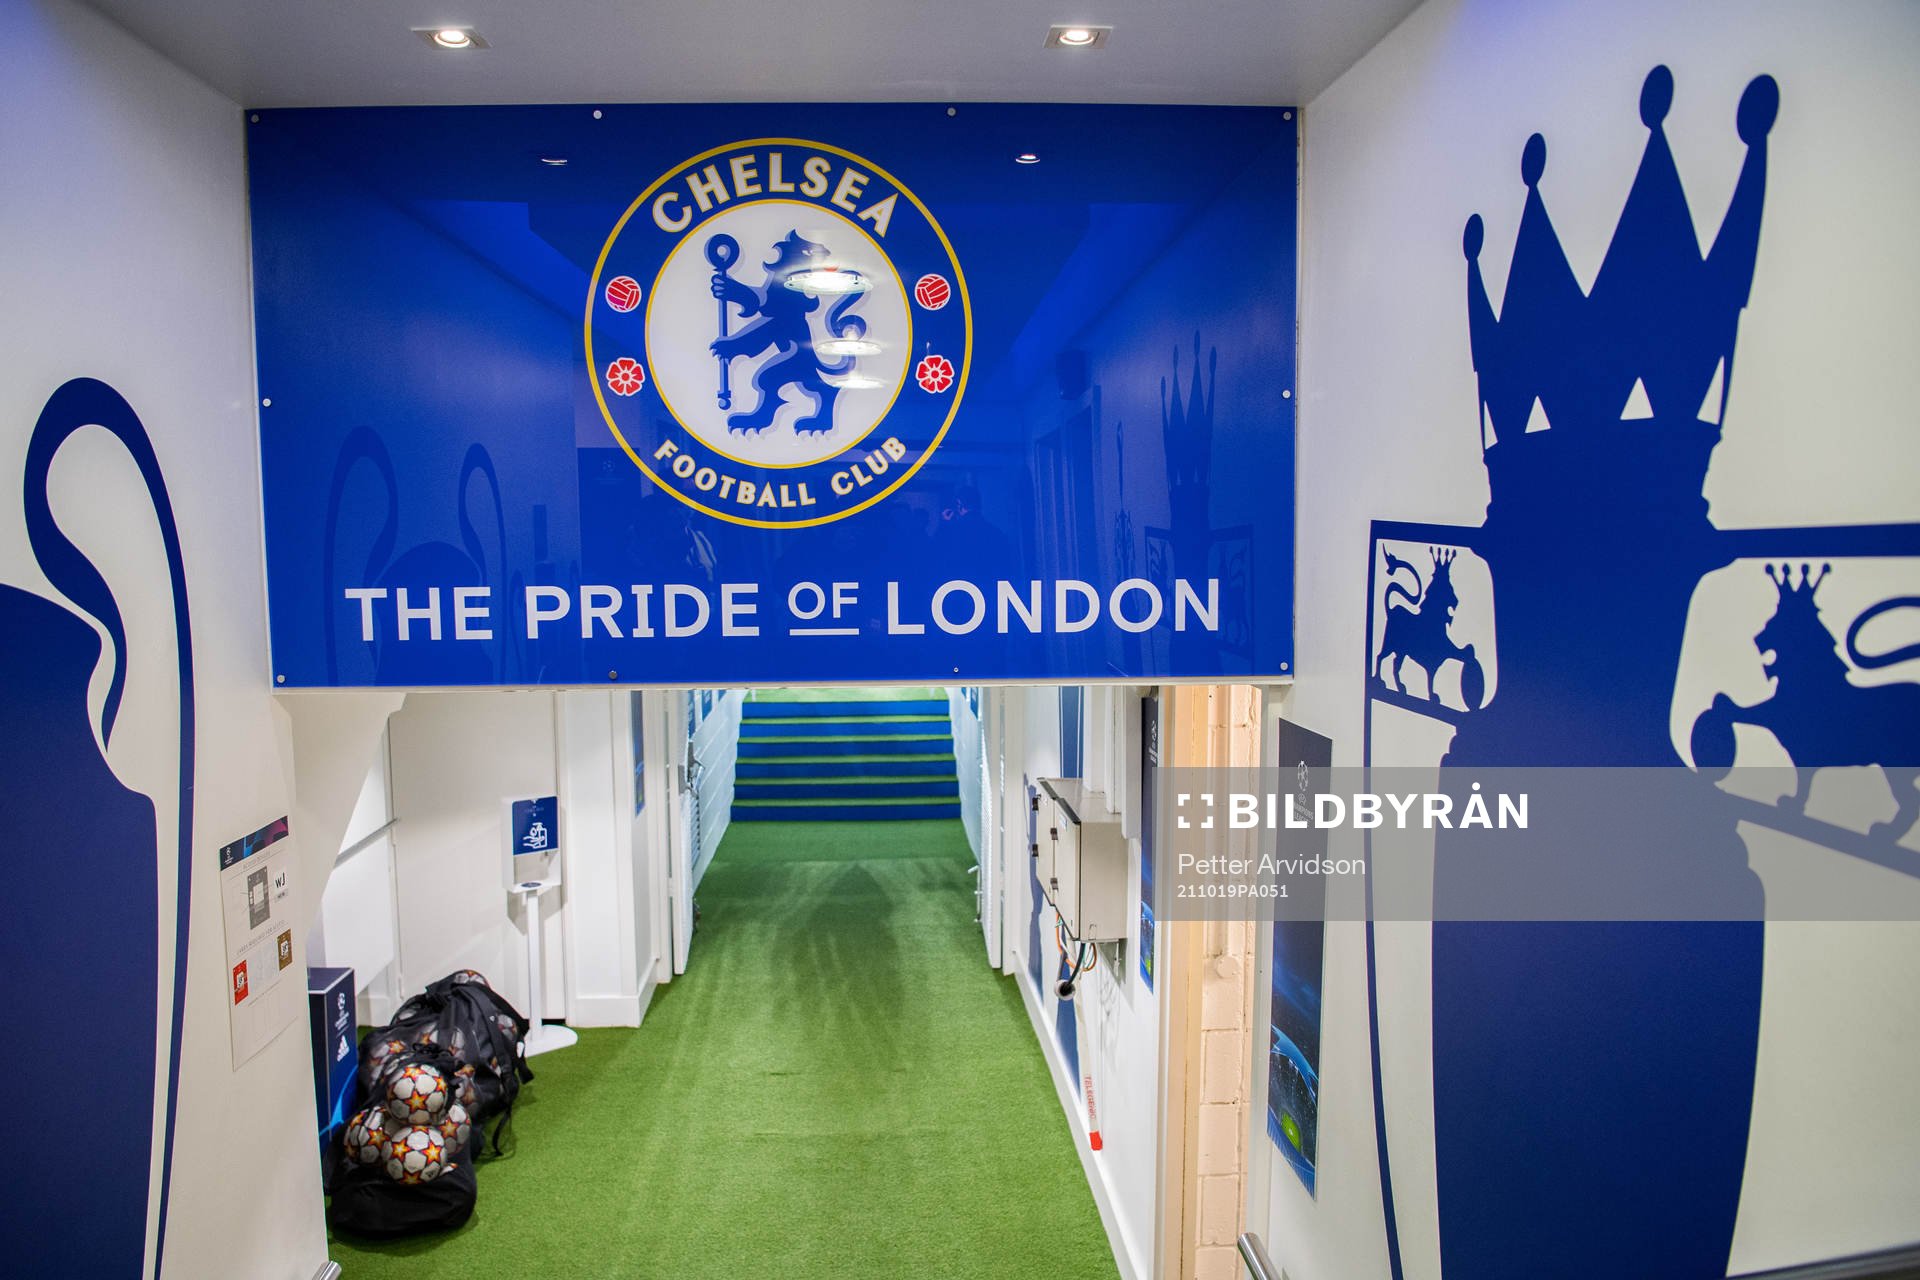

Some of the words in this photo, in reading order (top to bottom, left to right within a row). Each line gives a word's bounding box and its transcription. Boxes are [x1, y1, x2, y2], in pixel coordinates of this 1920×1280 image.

[652, 152, 899, 238] CHELSEA
[653, 438, 816, 508] FOOTBALL
[830, 436, 908, 496] CLUB
[345, 587, 493, 641] THE
[525, 583, 760, 639] PRIDE
[787, 581, 860, 622] OF
[887, 578, 1220, 635] LONDON
